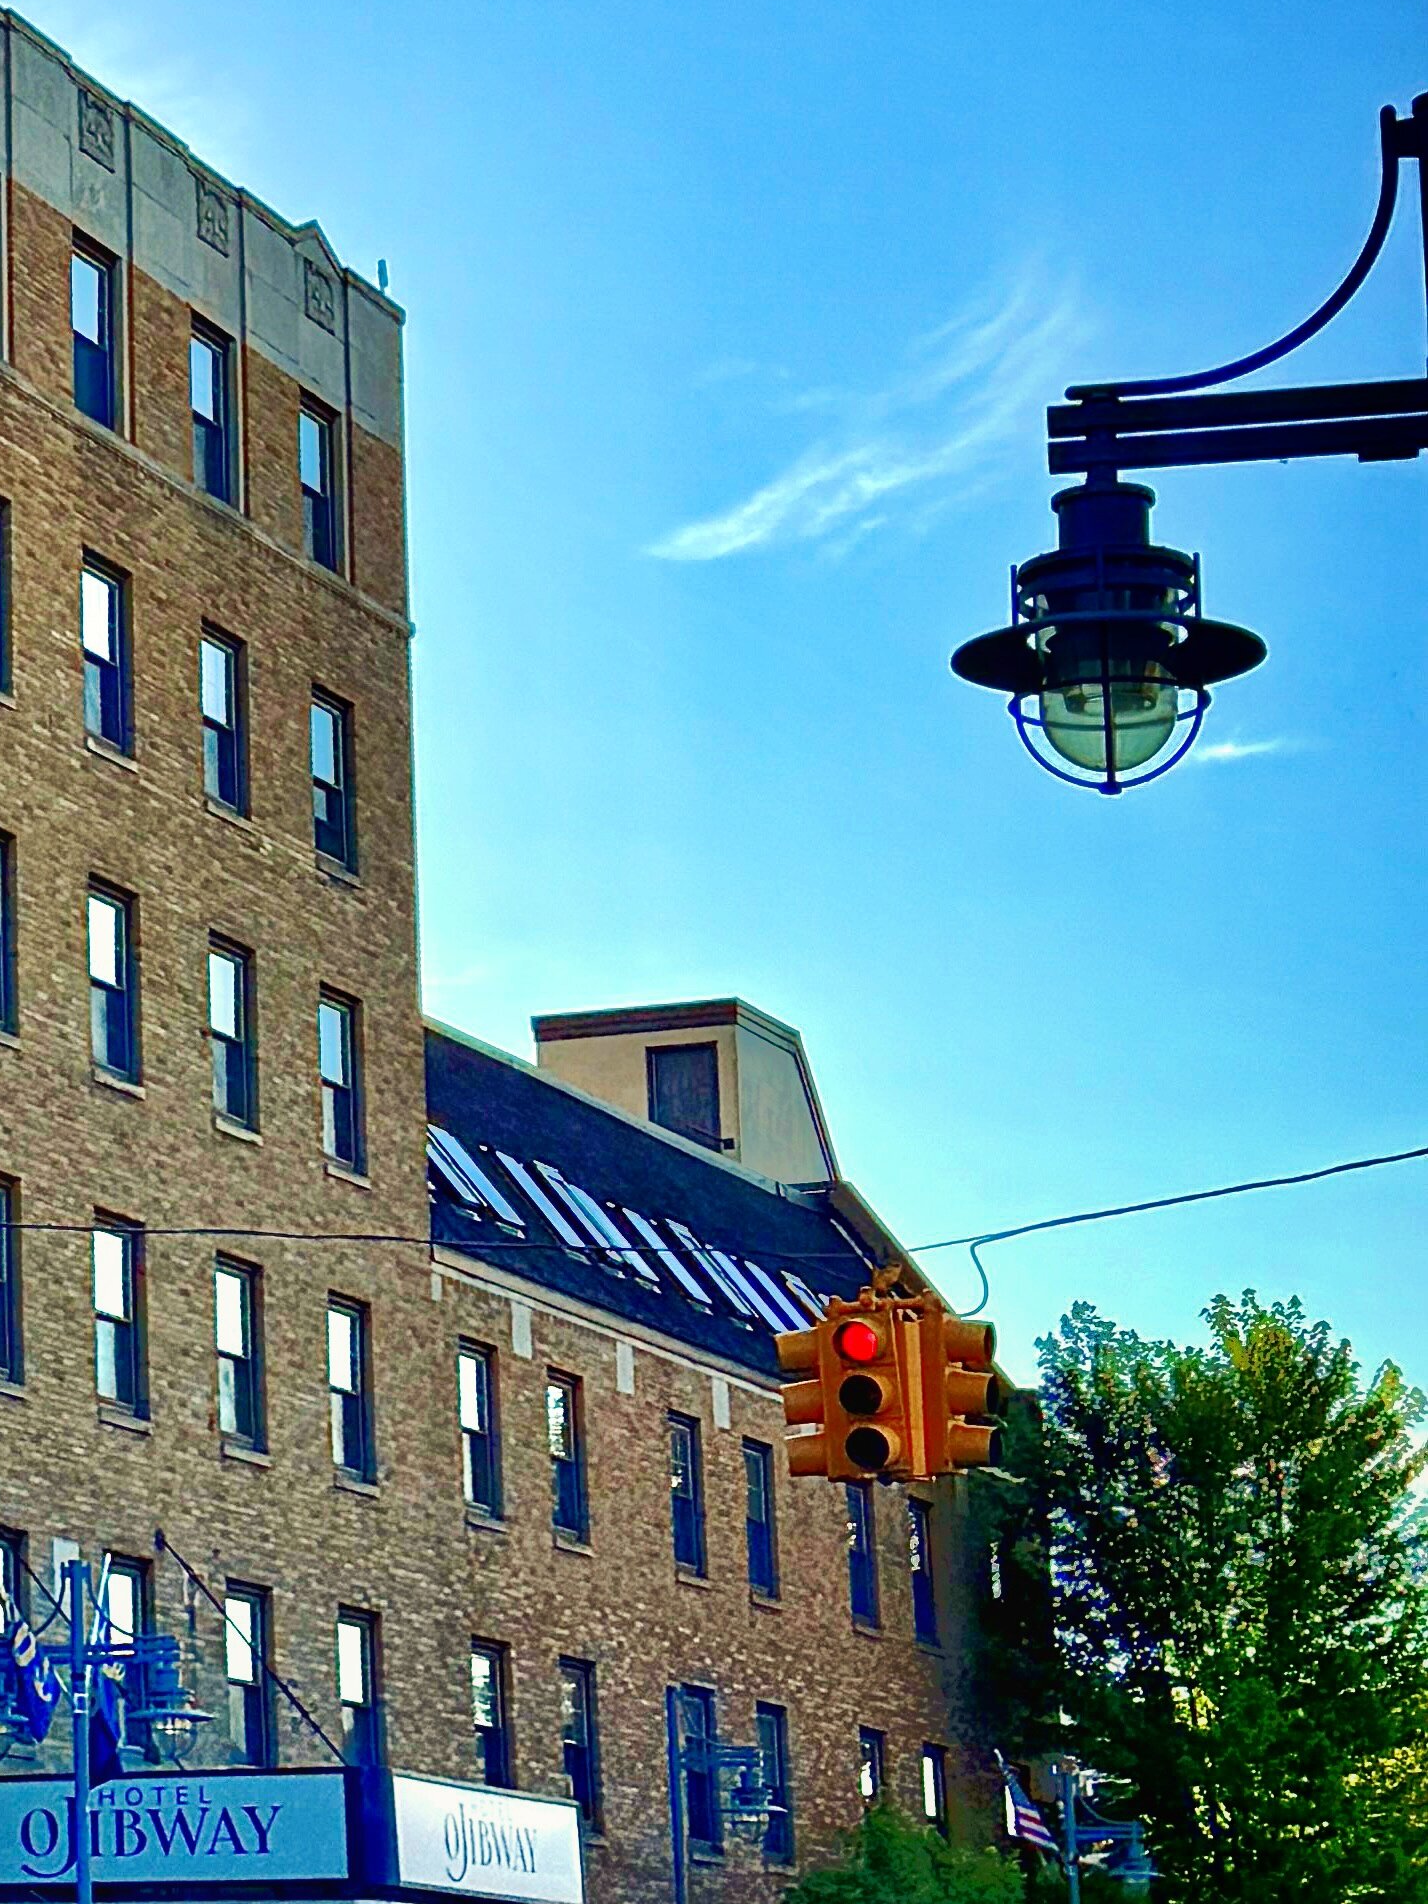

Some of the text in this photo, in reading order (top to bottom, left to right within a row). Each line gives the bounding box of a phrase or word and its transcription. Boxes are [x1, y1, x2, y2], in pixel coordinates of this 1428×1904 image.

[98, 1785, 213, 1807] HOTEL
[20, 1796, 283, 1879] OJIBWAY
[444, 1802, 537, 1882] OJIBWAY
